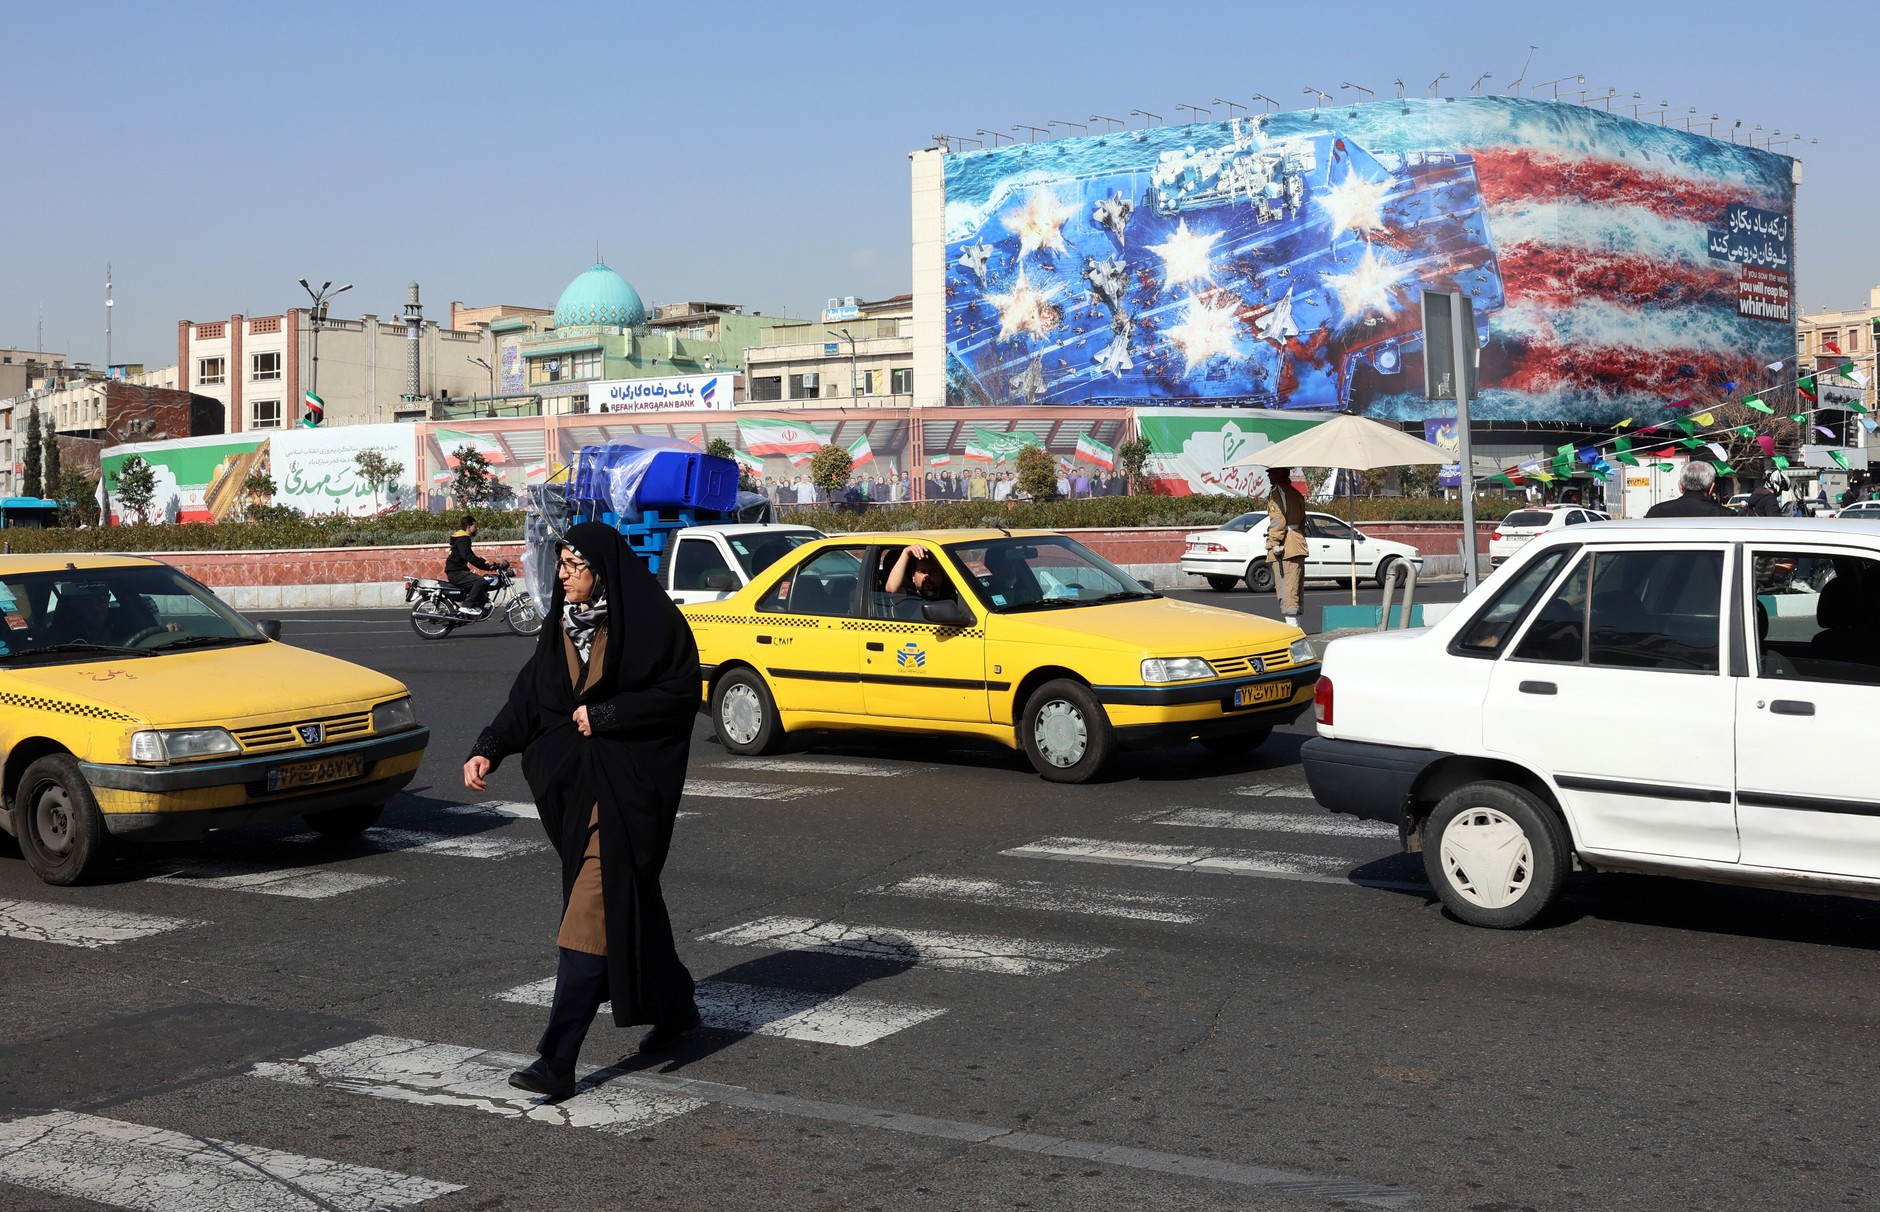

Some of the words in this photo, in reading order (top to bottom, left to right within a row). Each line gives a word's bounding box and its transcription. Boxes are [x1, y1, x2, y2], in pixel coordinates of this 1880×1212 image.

[1729, 209, 1752, 235] بکارد
[1753, 213, 1767, 238] باد
[1757, 242, 1787, 268] طوفان
[1748, 270, 1757, 279] you
[1758, 272, 1768, 280] sow
[1740, 281, 1752, 293] you
[1753, 281, 1763, 294] will
[1764, 286, 1779, 299] reap
[1779, 285, 1788, 298] the
[1740, 295, 1788, 320] whirlwind
[610, 384, 643, 400] کارگران
[643, 383, 668, 398] رفاه
[669, 382, 695, 398] بانک
[611, 404, 633, 412] REFAH
[634, 401, 674, 410] KARGARAN
[675, 399, 695, 409] BANK
